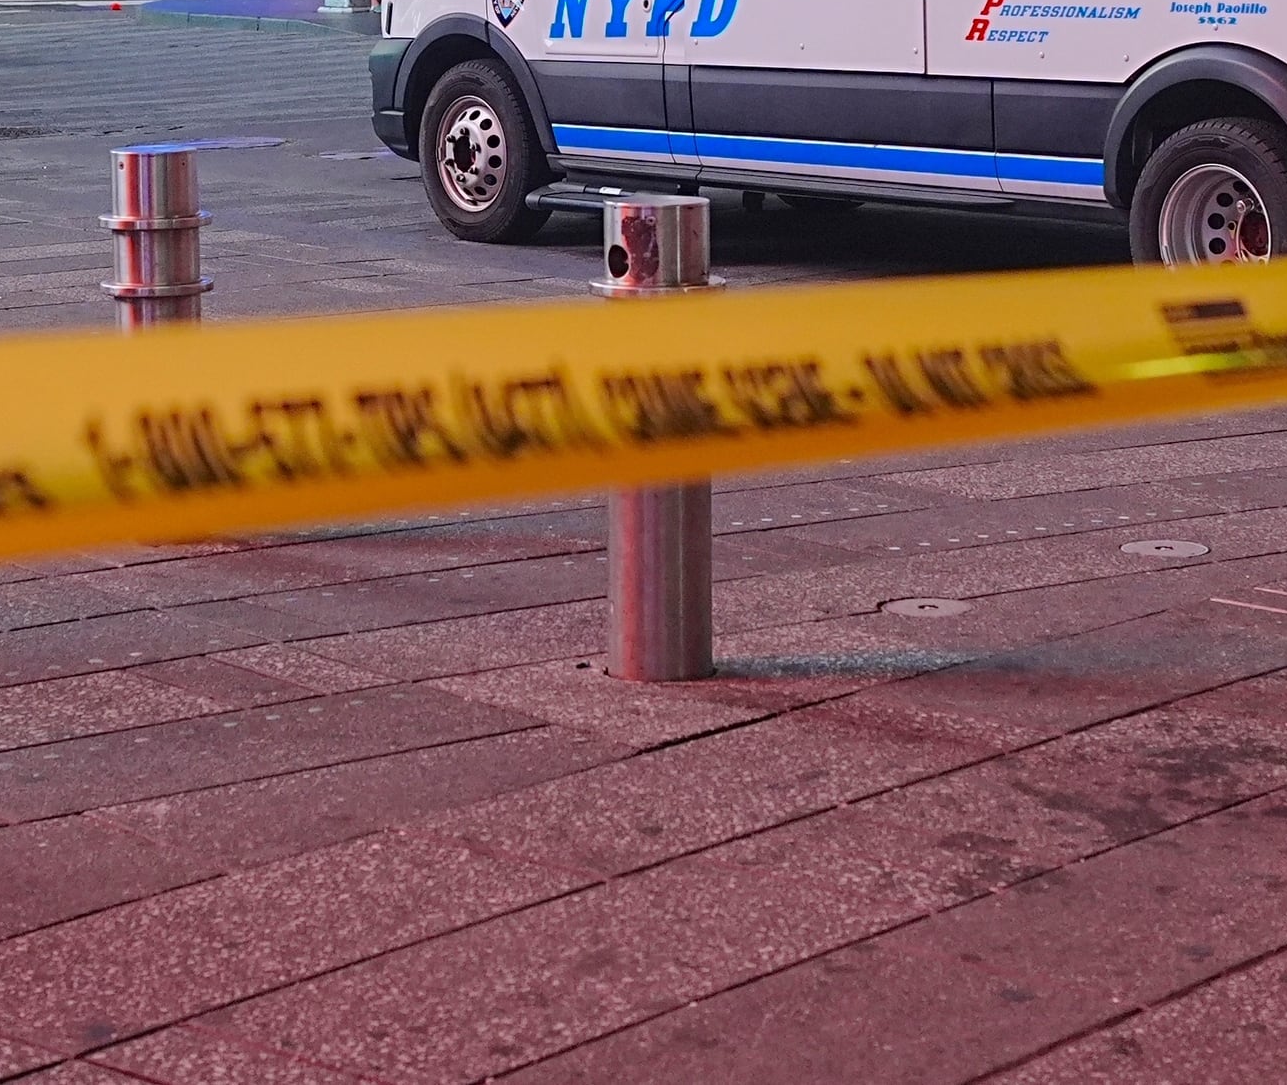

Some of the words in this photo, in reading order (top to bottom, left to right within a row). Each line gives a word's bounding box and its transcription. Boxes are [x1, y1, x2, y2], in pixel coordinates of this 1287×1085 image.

[1170, 1, 1211, 15] Joseph
[1217, 3, 1267, 14] Paolillo
[965, 18, 1049, 42] RESPECT
